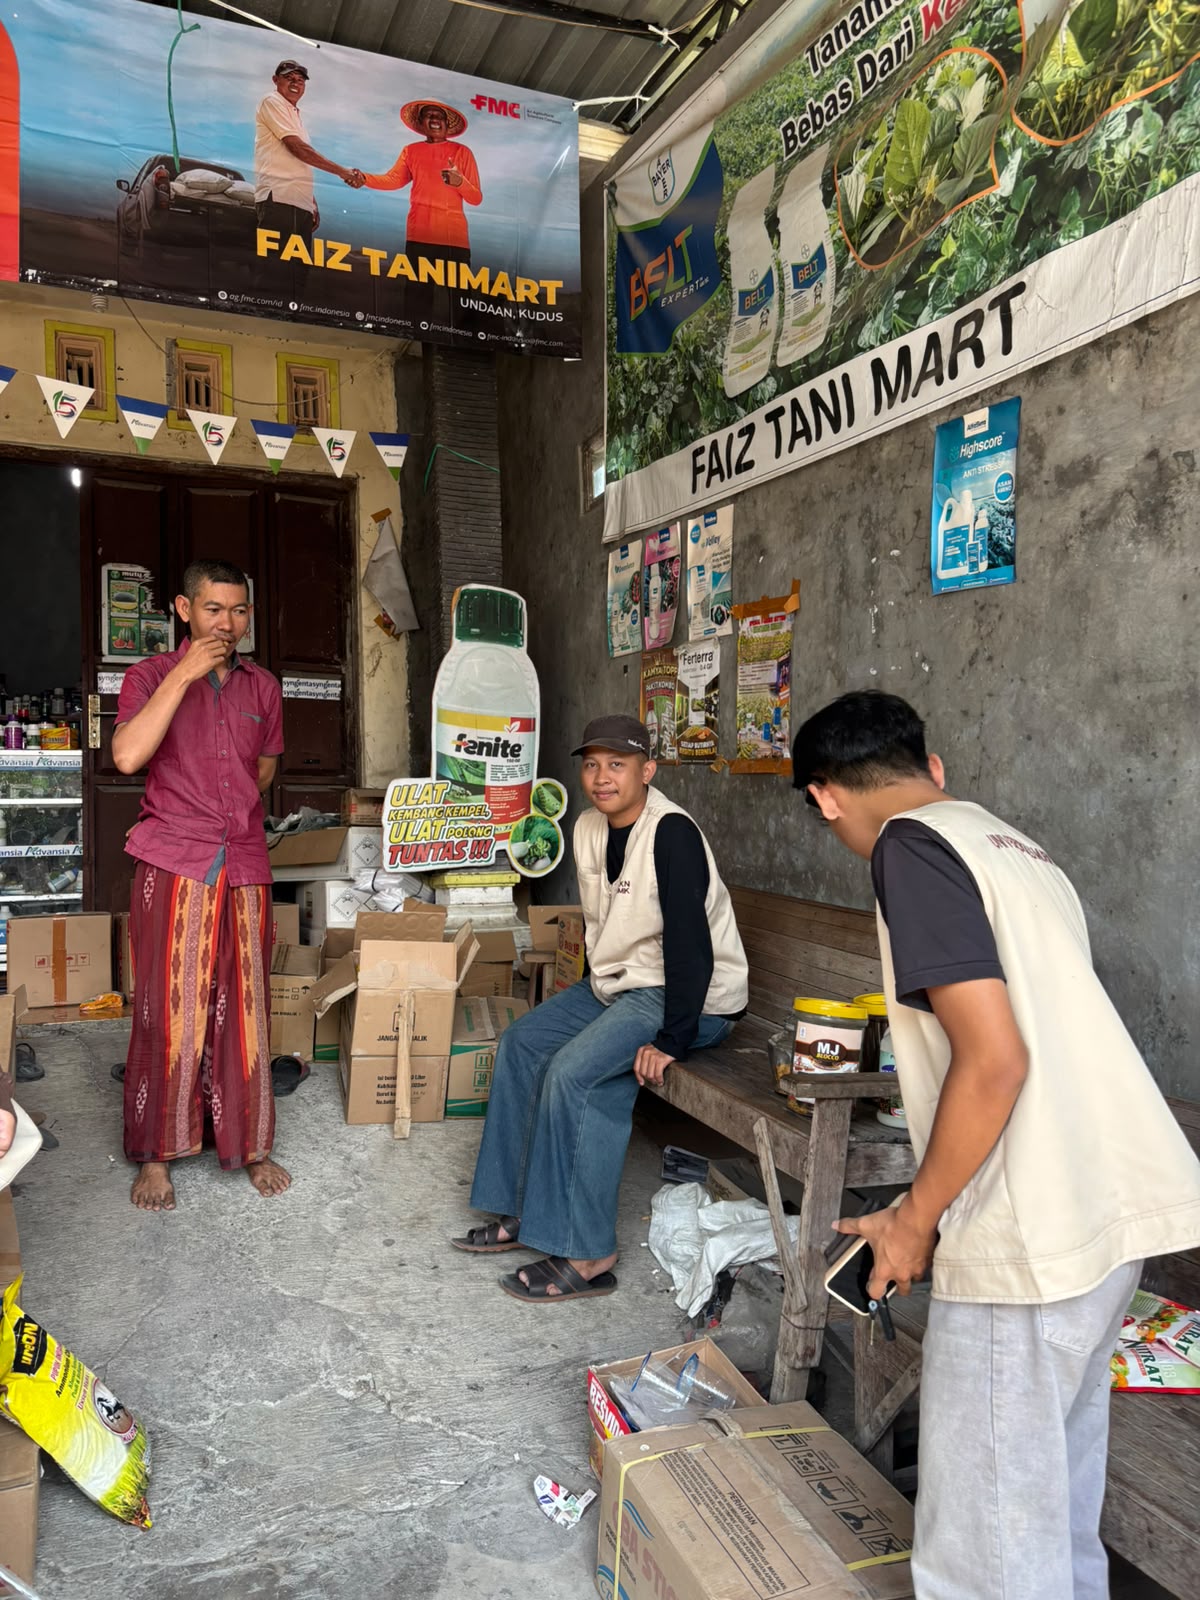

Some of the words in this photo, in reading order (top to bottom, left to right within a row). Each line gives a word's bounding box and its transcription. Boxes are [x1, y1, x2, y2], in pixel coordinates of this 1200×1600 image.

[781, 79, 854, 160] Bebas
[855, 15, 915, 98] Dari
[470, 94, 521, 119] FMC
[652, 158, 671, 187] BAYER
[256, 228, 352, 271] FAIZ
[362, 247, 563, 305] TANIMART
[630, 224, 693, 321] BELT
[798, 259, 819, 283] BELT
[661, 279, 700, 308] EXPERT
[744, 284, 767, 310] BELT
[299, 303, 350, 317] fmc.indonesia
[460, 297, 516, 319] UNDAAN,
[518, 308, 564, 322] KUDUS
[690, 421, 756, 494] FAIZ
[765, 372, 855, 459] TANI
[870, 281, 1027, 417] MART
[960, 435, 1003, 458] Highscore
[682, 651, 714, 665] Ferterra
[454, 733, 523, 758] fenite
[36, 757, 81, 766] Advansia
[391, 782, 448, 807] ULAT
[388, 807, 444, 821] KEMBANG
[389, 819, 447, 844] ULAT
[446, 825, 493, 839] POLONG
[25, 846, 70, 856] Advansia
[389, 840, 468, 865] TUNTAS
[817, 1042, 840, 1055] MJ
[1118, 1338, 1165, 1386] NITRAT
[55, 1357, 70, 1397] Ammonium
[726, 1491, 756, 1525] PERHATIAN
